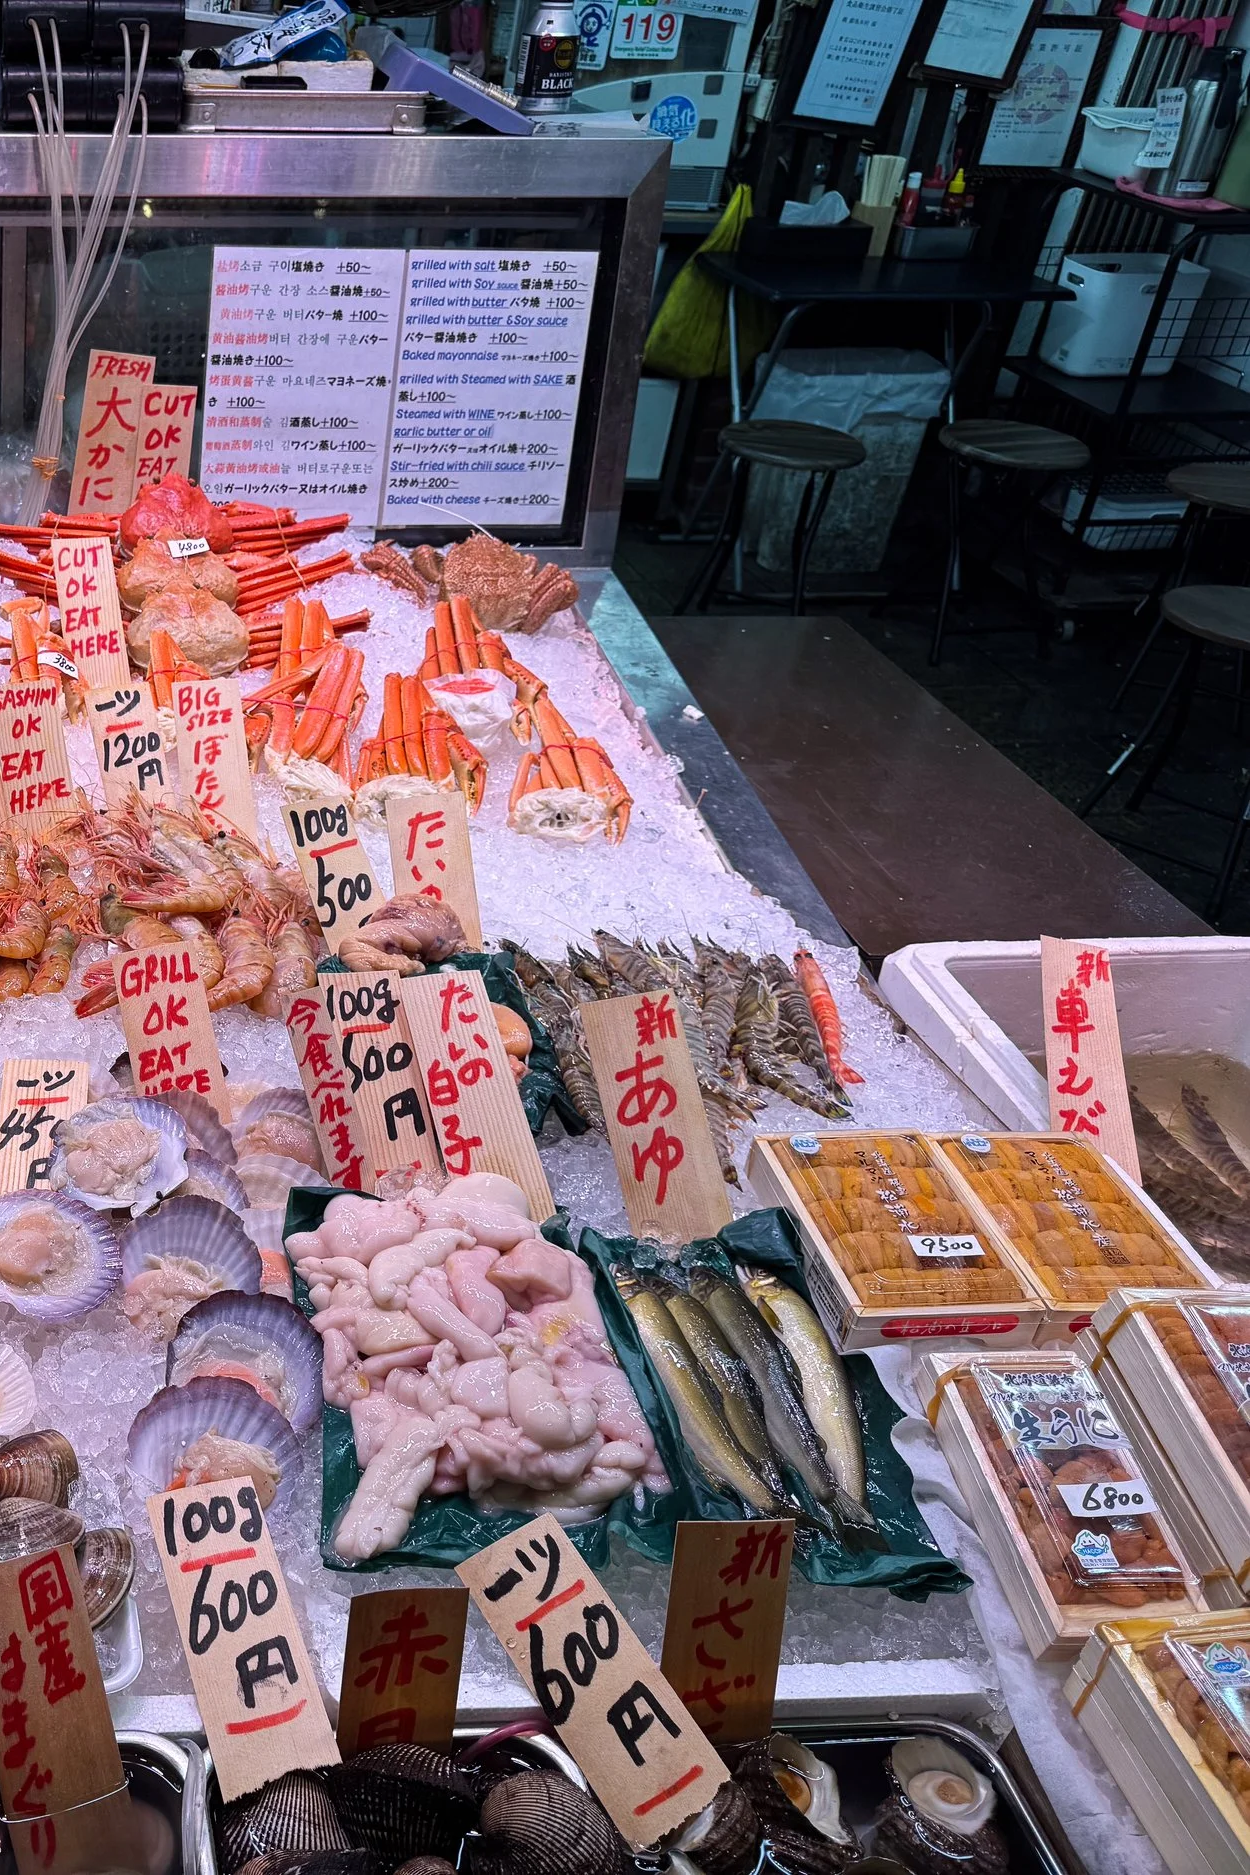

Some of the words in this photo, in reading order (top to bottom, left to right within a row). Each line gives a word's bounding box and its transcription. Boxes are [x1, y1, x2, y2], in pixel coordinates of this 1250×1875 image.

[622, 13, 676, 42] 119
[541, 78, 574, 90] BLACK
[411, 259, 447, 271] grilled
[449, 259, 472, 270] with
[474, 260, 496, 272] salt
[411, 278, 447, 289] grilled
[449, 278, 472, 289] with
[474, 278, 495, 290] Soy
[497, 282, 519, 290] sauce
[410, 296, 445, 308] grilled
[448, 296, 470, 307] with
[471, 297, 507, 308] butter
[405, 314, 440, 326] grilled
[443, 314, 465, 325] with
[468, 315, 503, 326] butter
[536, 316, 568, 326] sauce
[90, 356, 152, 382] FRESH
[402, 350, 435, 361] Baked
[437, 351, 499, 362] mayonnaise
[399, 374, 433, 385] grilled
[436, 374, 458, 385] with
[461, 374, 507, 385] Steamed
[508, 374, 531, 385] with
[533, 375, 564, 386] SAKE
[565, 375, 576, 385] 酒
[144, 391, 196, 417] CUT
[396, 409, 441, 420] Steamed
[443, 409, 467, 420] with
[468, 409, 496, 421] WINE
[79, 386, 136, 506] 大かに
[144, 425, 182, 450] OK
[394, 426, 425, 438] garlic
[427, 426, 461, 437] butter
[464, 429, 476, 438] or
[478, 426, 492, 437] oil
[136, 456, 178, 478] EAT
[390, 461, 444, 472] Stir-fried
[447, 461, 469, 472] with
[471, 461, 492, 472] chili
[494, 462, 525, 472] sauce
[387, 495, 419, 505] Baked
[421, 495, 443, 505] with
[445, 495, 481, 505] cheese
[58, 544, 104, 572] CUT
[65, 573, 97, 599] OK
[64, 605, 102, 633] EAT
[70, 630, 121, 659] HERE
[53, 653, 76, 672] 3800
[177, 685, 222, 717] BIG
[11, 716, 42, 739] OK
[186, 708, 234, 731] SIZE
[1, 749, 47, 782] EAT
[103, 731, 161, 773] 1200
[138, 757, 165, 791] 円
[9, 777, 72, 815] HERE
[289, 803, 348, 848] 100g
[316, 855, 372, 928] 500
[120, 951, 199, 998] GRILL
[326, 978, 400, 1023] 100g
[143, 994, 189, 1036] OK
[138, 1041, 192, 1083] EAT
[383, 1087, 427, 1141] 円
[920, 1237, 973, 1253] 9500
[1012, 1407, 1120, 1446] 生うに
[1082, 1483, 1144, 1511] 6800
[163, 1486, 263, 1557] 100g
[188, 1564, 278, 1656] 600
[235, 1635, 300, 1709] 円
[529, 1603, 619, 1727] 600
[607, 1680, 681, 1767] 円
